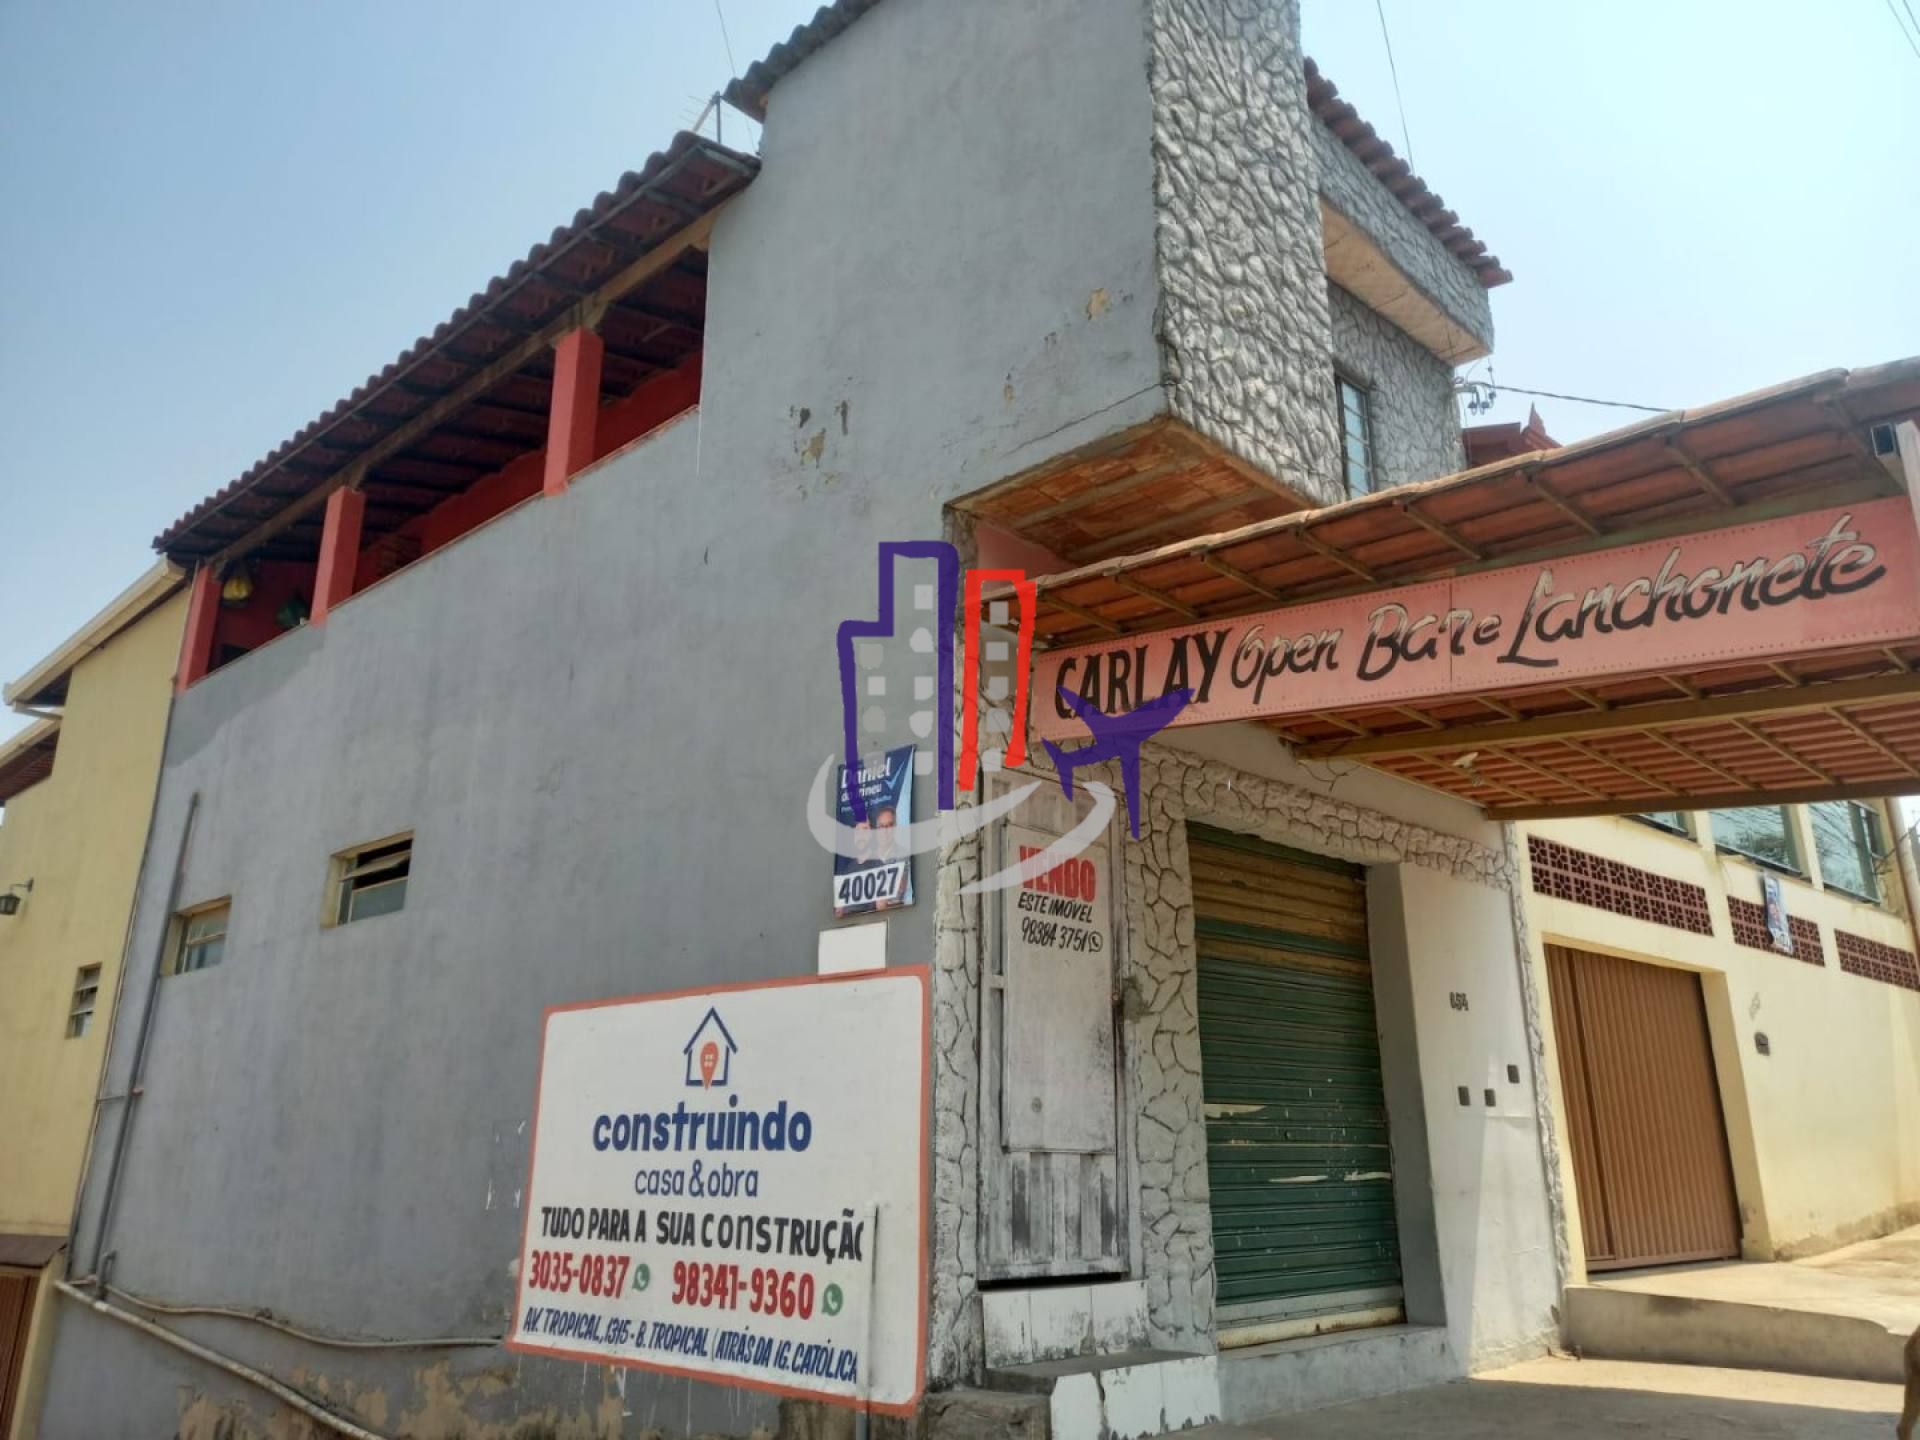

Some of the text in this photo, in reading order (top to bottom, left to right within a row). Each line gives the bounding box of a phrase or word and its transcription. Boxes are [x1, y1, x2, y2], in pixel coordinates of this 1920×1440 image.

[1231, 624, 1343, 704] Open
[1473, 614, 1501, 646] e
[1497, 513, 1886, 667] Lanchonete
[839, 867, 898, 904] 40027
[1018, 891, 1093, 924] ESTE IMOVEL
[593, 1094, 812, 1152] construindo
[634, 1159, 759, 1198] casa & obra
[541, 1206, 585, 1239] TUDO
[587, 1208, 630, 1243] PARA
[634, 1210, 647, 1243] A
[656, 1210, 696, 1247] SUA
[529, 1250, 815, 1321] 3035-0837 98341-9360
[523, 1306, 545, 1332] AV.
[648, 1321, 709, 1357] TROPICAL
[753, 1336, 773, 1368] DA
